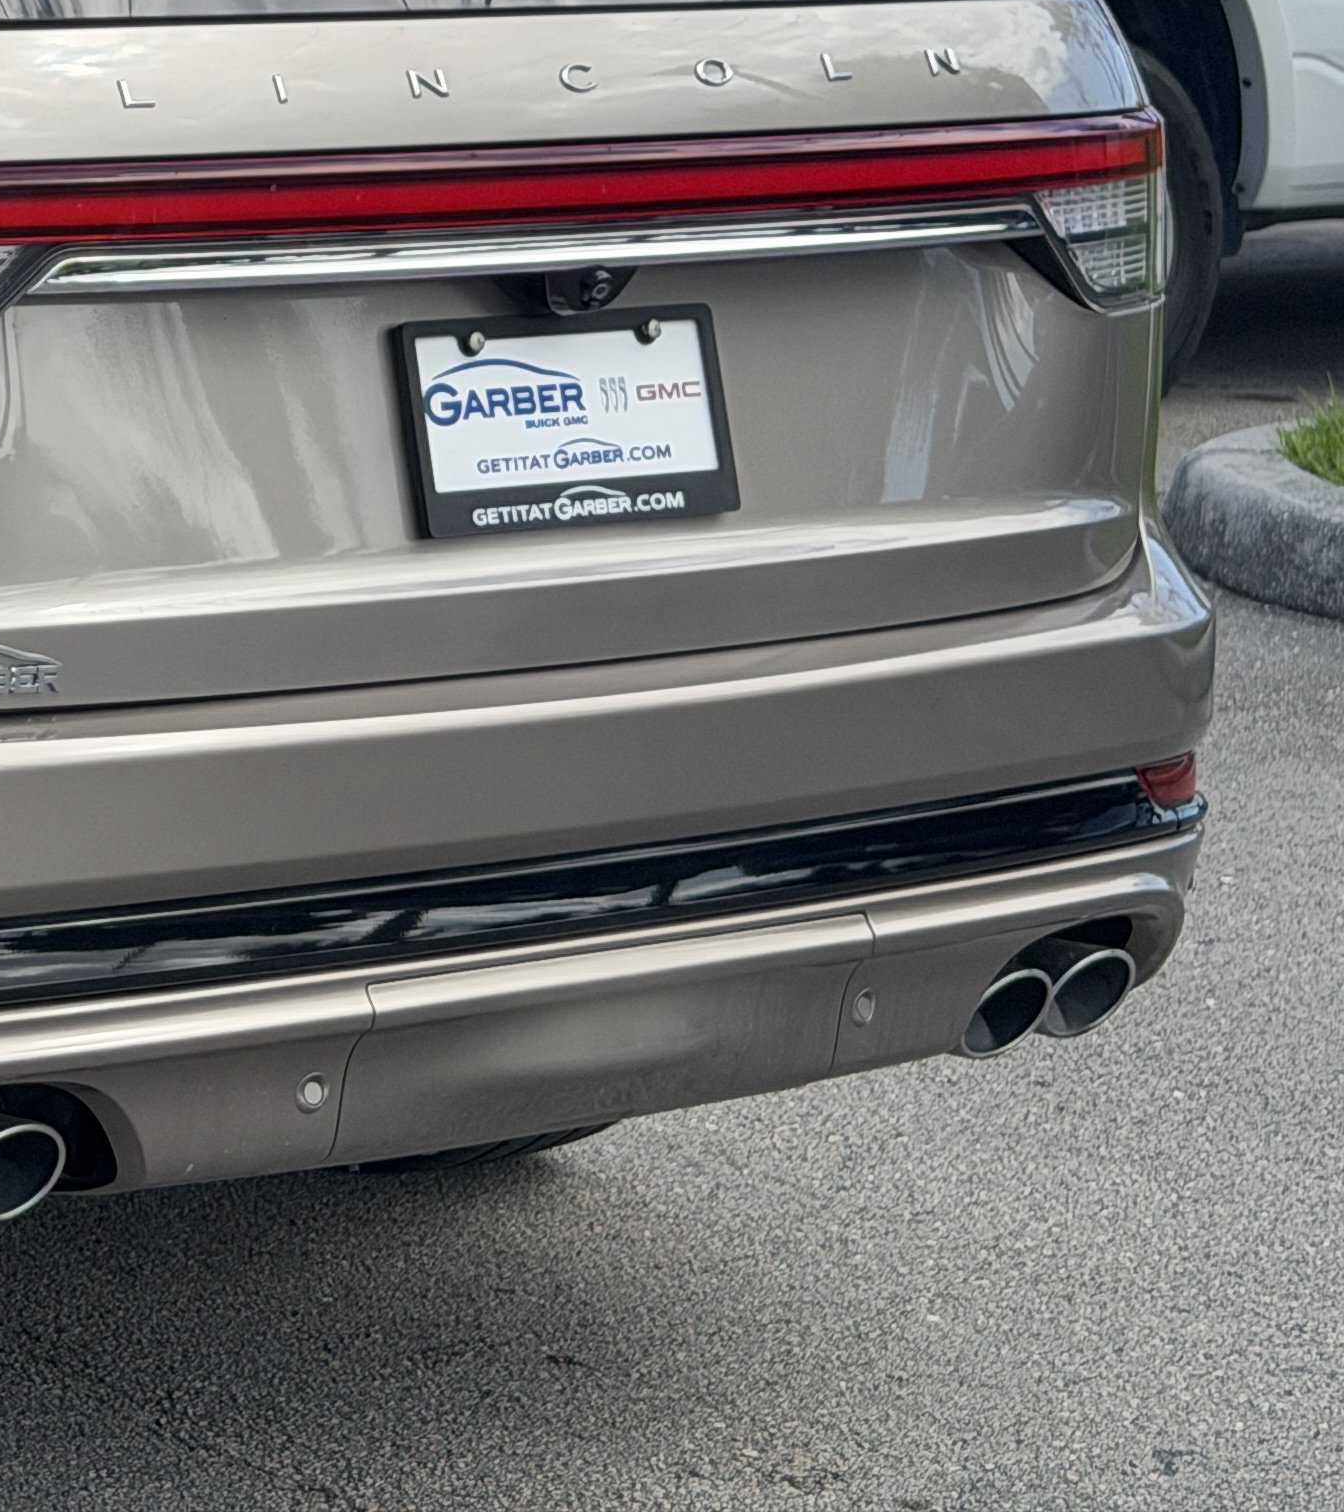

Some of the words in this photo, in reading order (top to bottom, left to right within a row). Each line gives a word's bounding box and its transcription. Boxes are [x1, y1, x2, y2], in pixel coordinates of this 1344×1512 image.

[116, 47, 962, 108] LINCOLN
[423, 379, 587, 427] GARBER
[635, 381, 702, 403] GMC
[525, 417, 560, 430] BUICK
[563, 415, 589, 426] GMC
